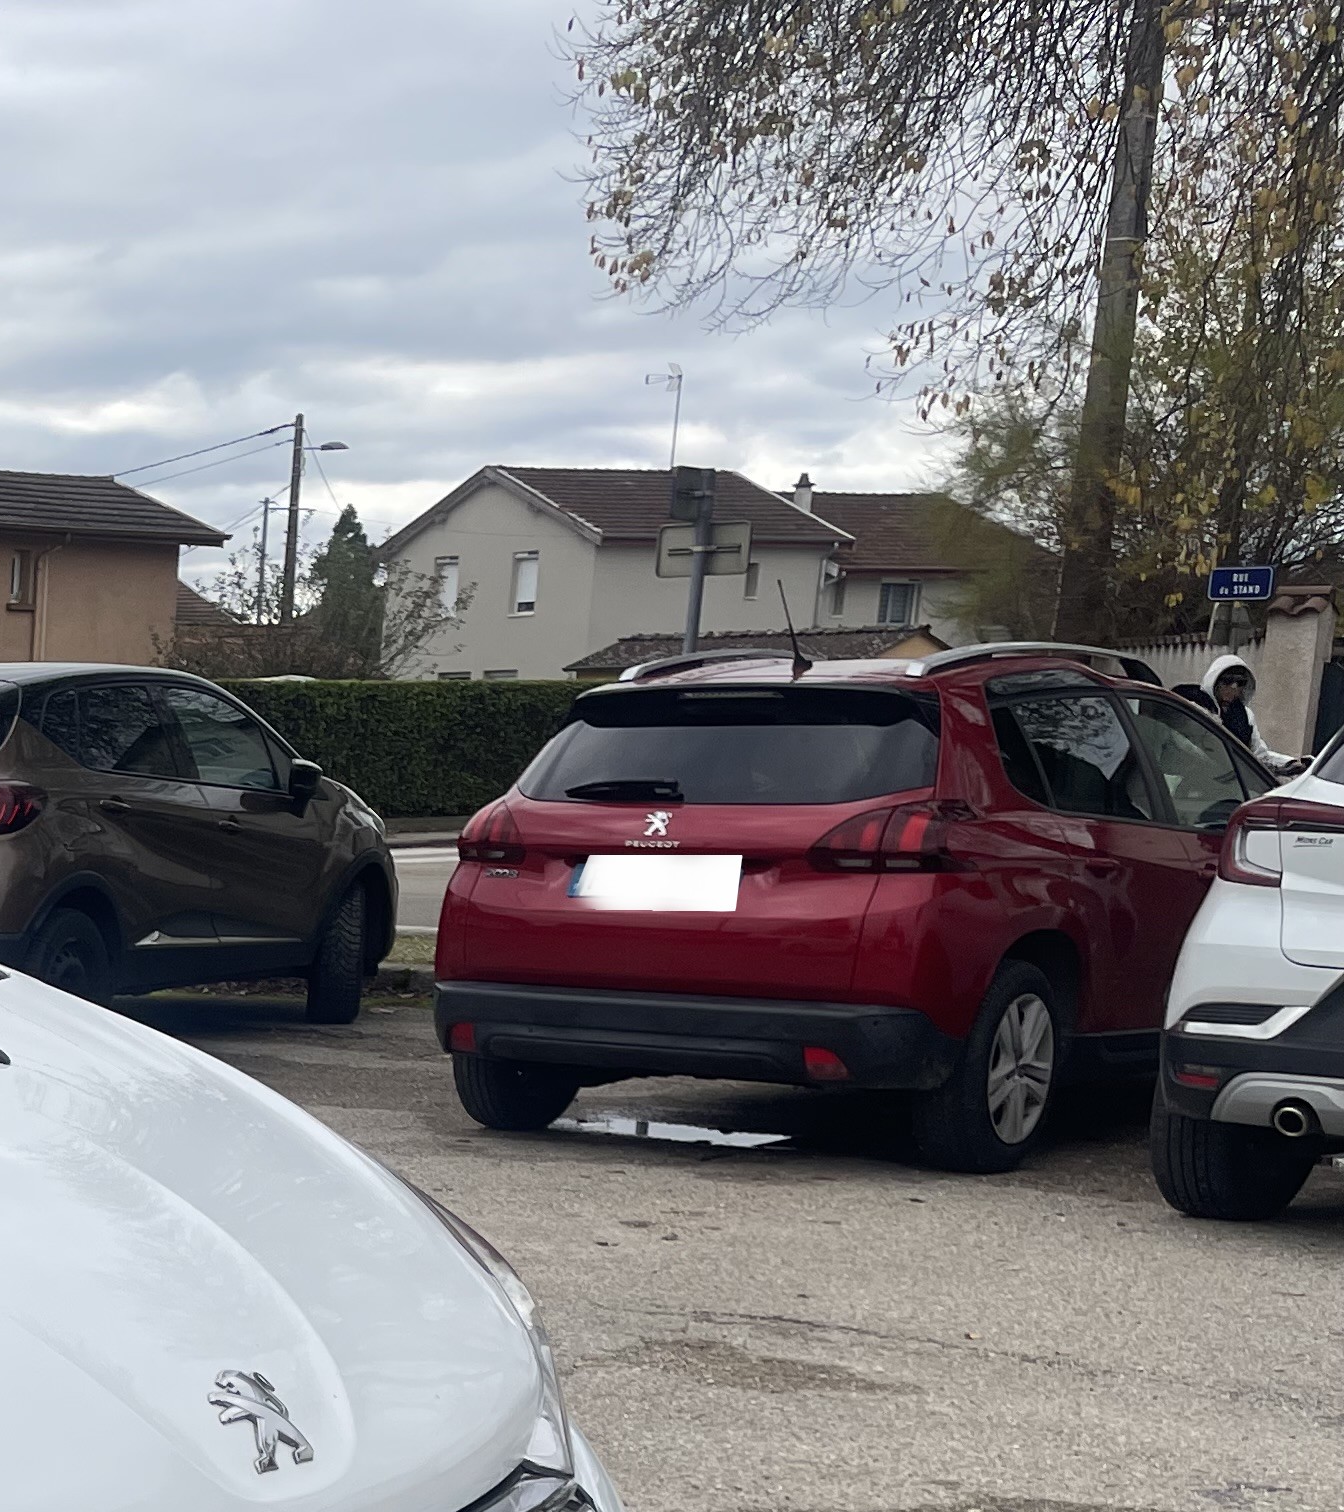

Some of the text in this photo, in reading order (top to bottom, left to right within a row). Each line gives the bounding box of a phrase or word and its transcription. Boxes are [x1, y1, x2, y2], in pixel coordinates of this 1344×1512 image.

[1233, 573, 1249, 582] RUE
[1219, 585, 1260, 595] du STAND
[624, 839, 681, 849] PEUGEOT
